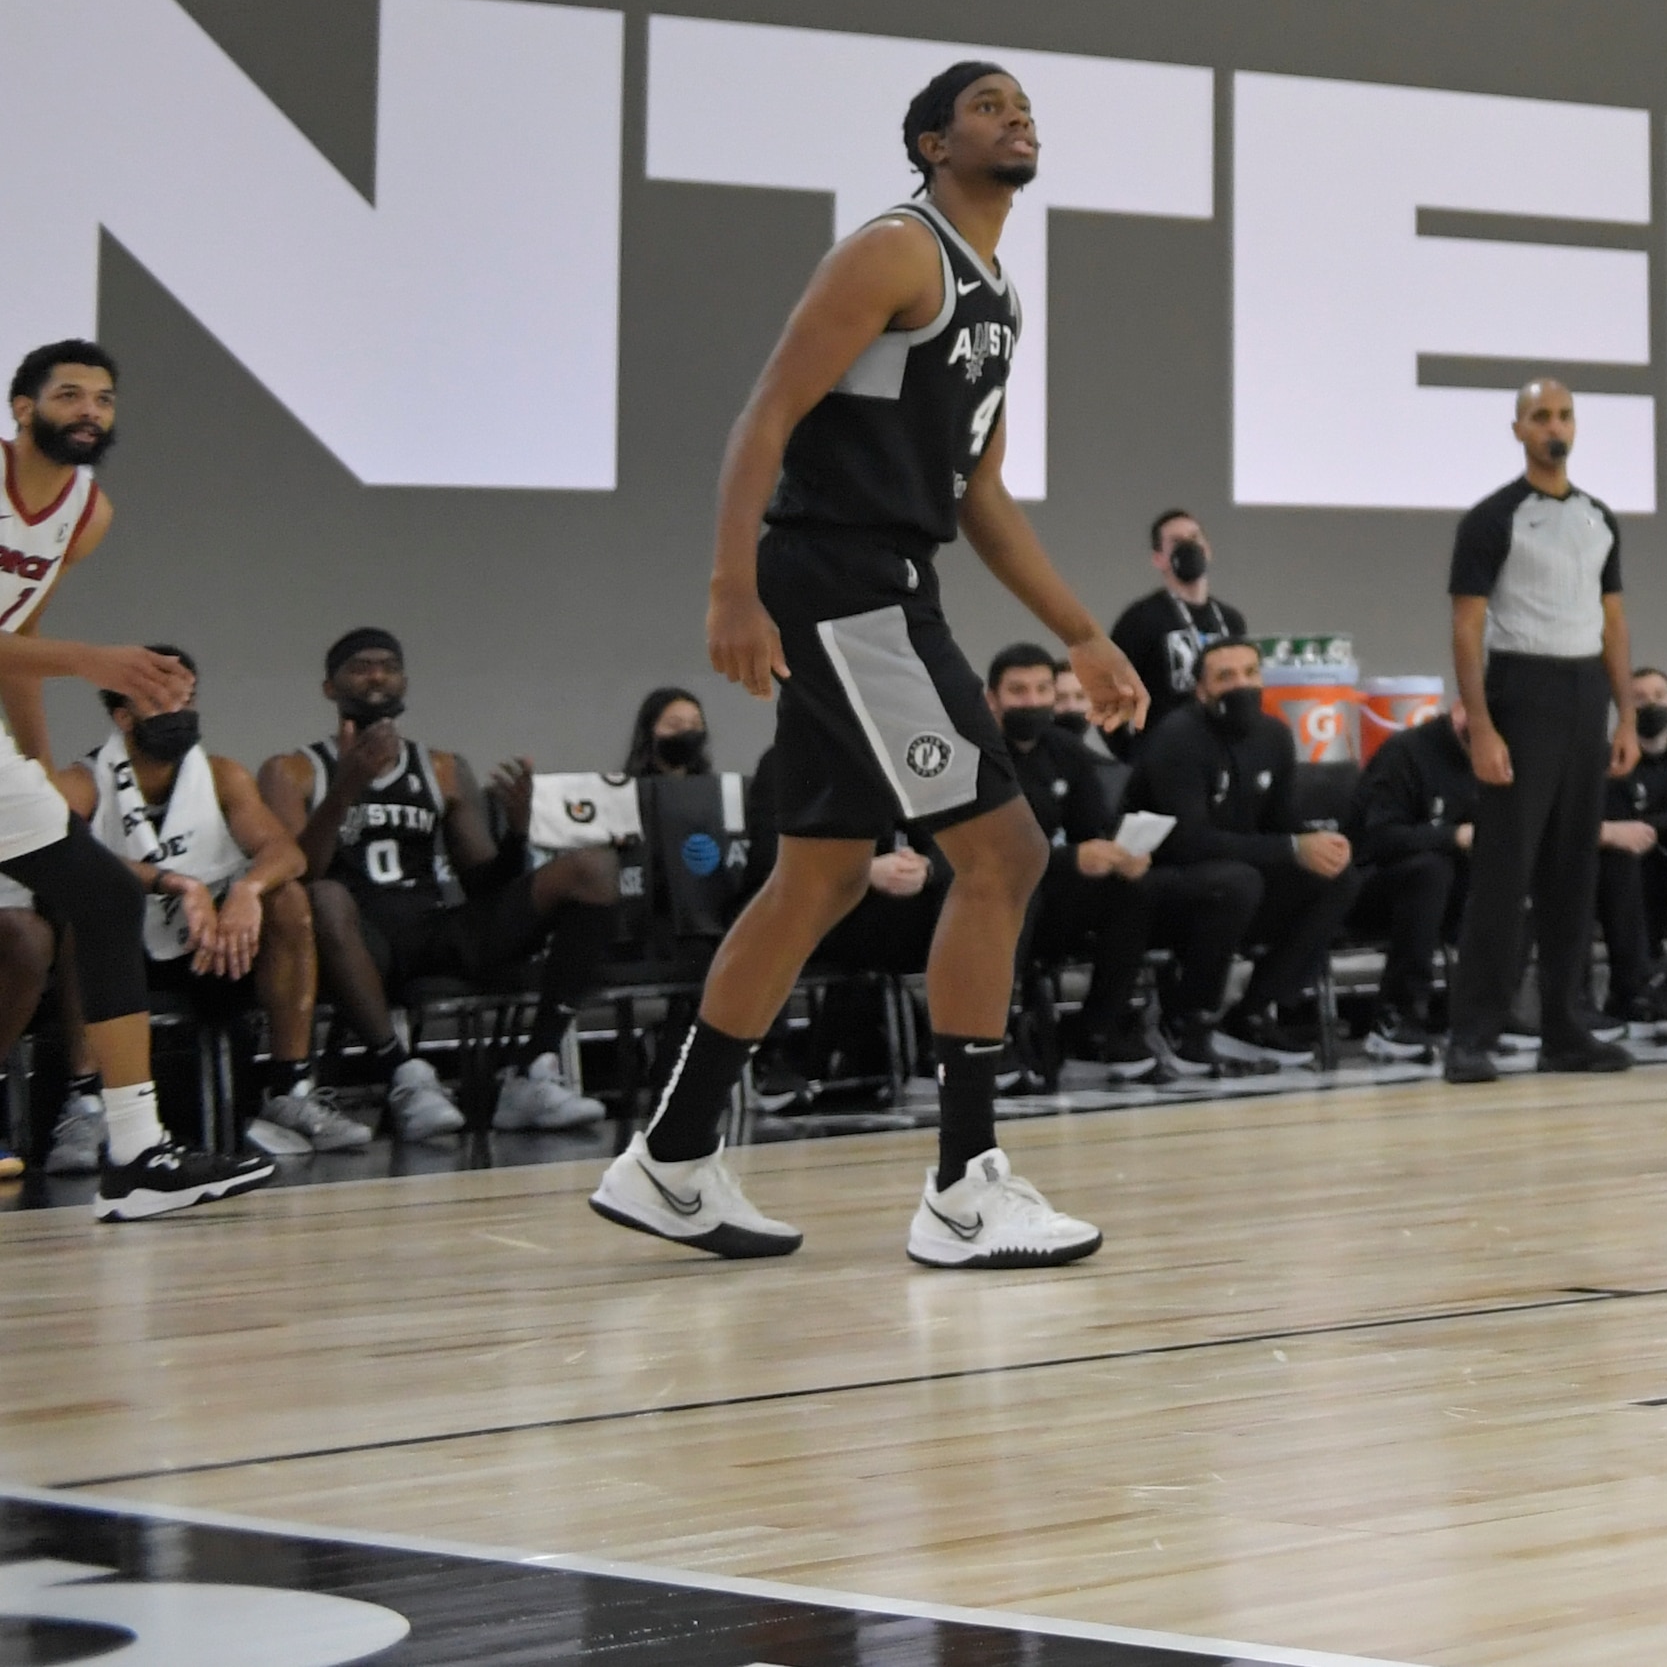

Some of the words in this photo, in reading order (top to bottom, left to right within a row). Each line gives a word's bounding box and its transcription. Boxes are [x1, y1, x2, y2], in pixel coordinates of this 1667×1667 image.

[948, 321, 1015, 374] AUST
[345, 802, 436, 835] USTIN
[365, 838, 403, 884] 0
